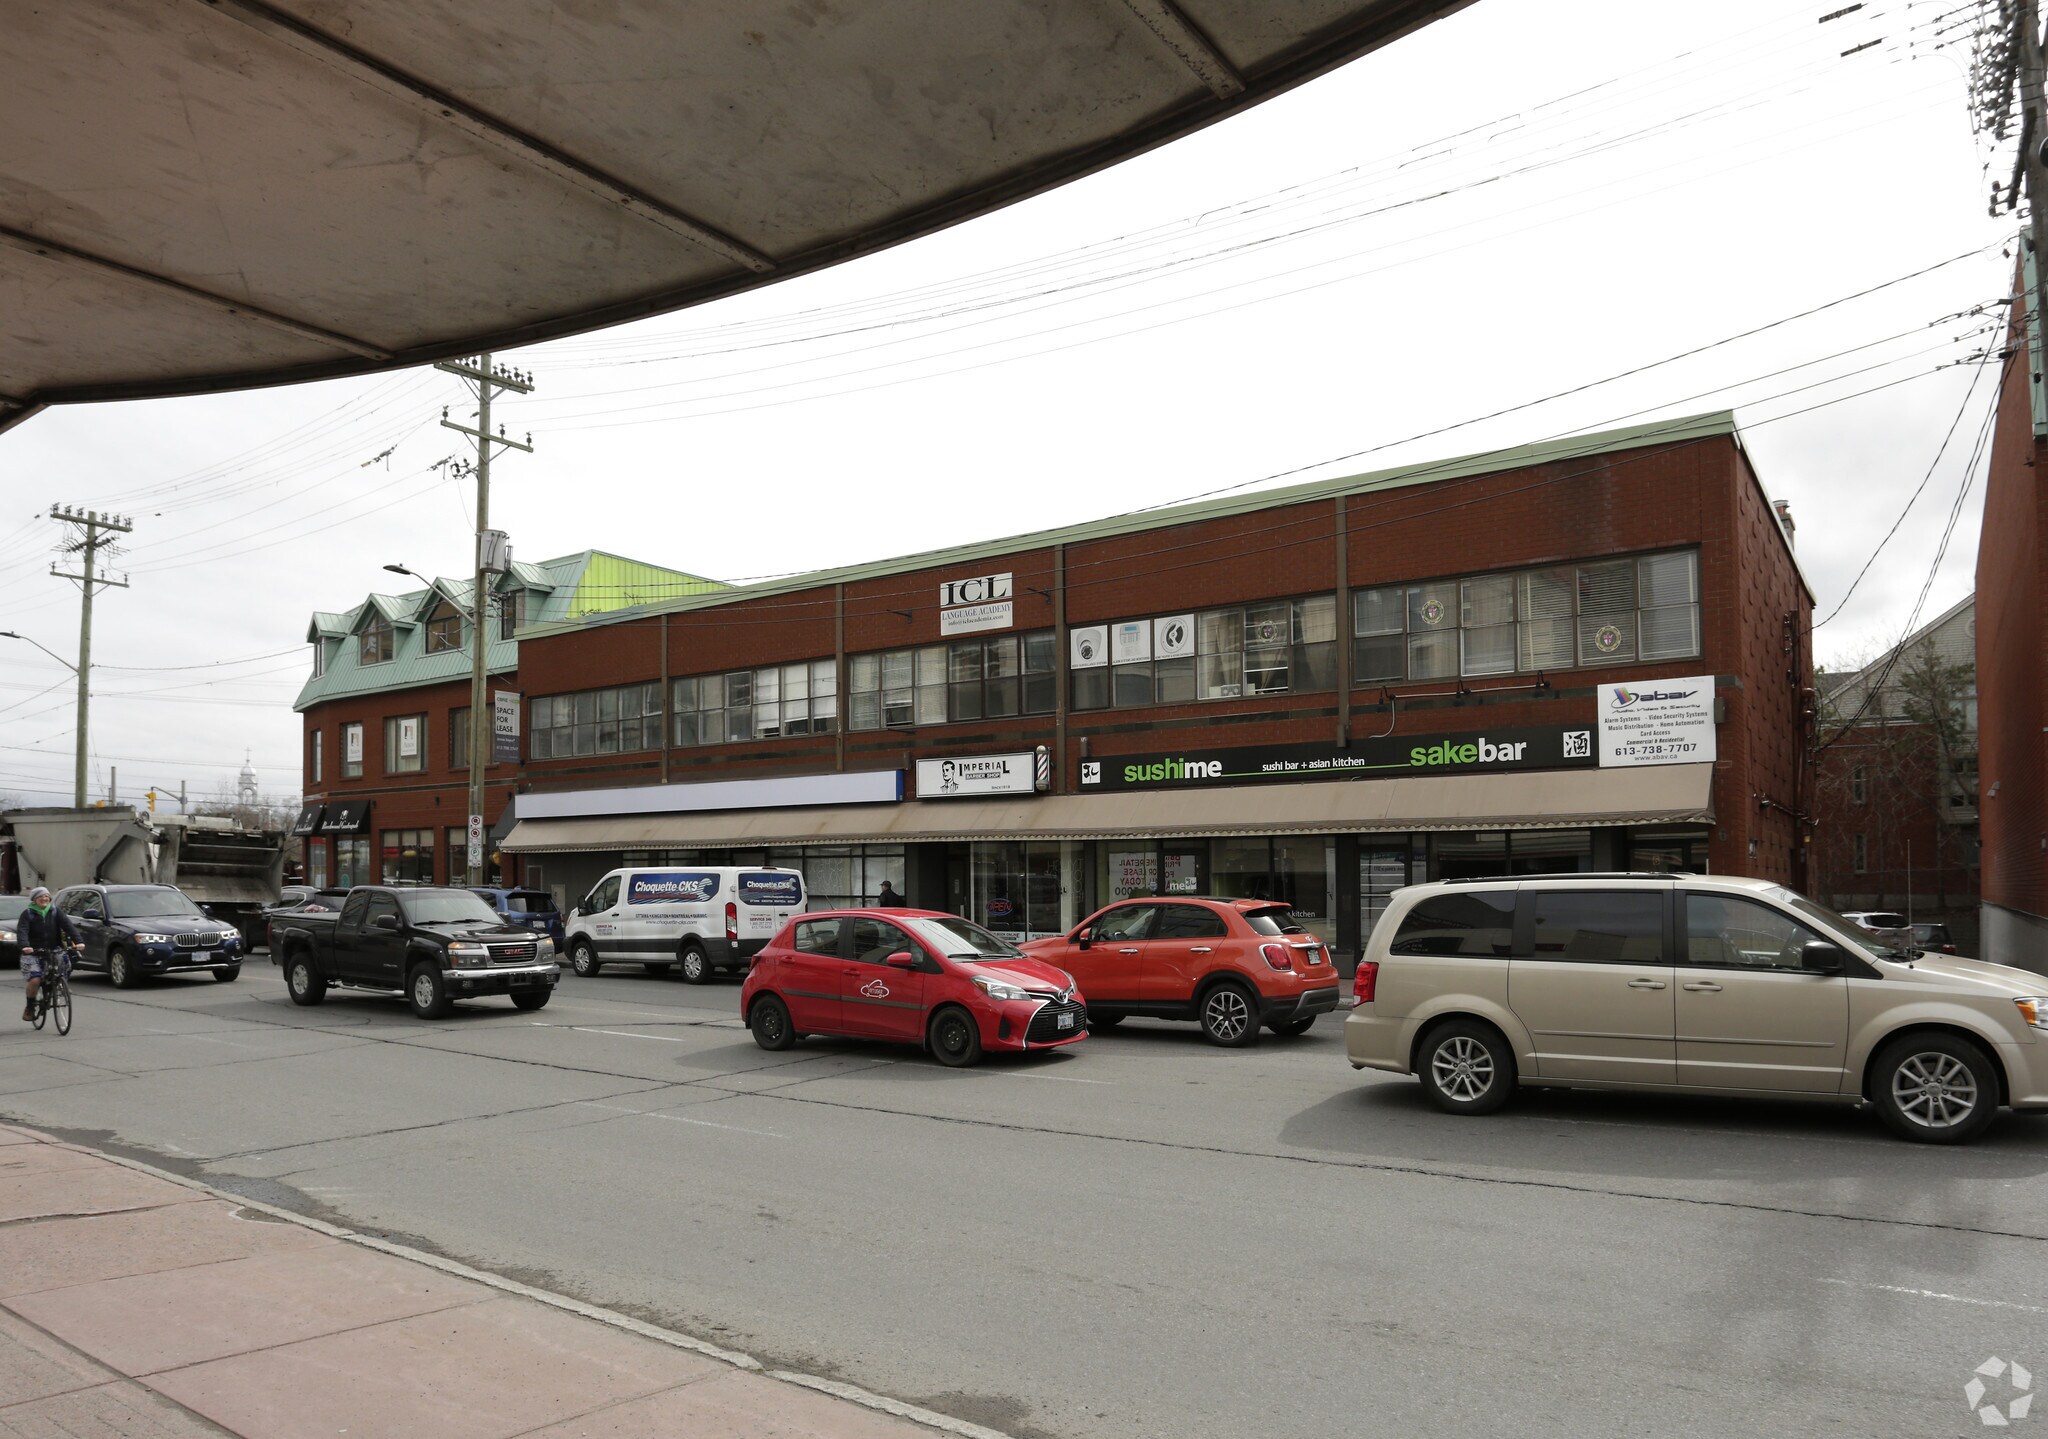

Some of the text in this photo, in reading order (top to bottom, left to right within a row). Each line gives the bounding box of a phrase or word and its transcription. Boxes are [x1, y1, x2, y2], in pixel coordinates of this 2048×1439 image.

[946, 576, 1006, 606] ICL
[942, 603, 1012, 620] LANGUAGE ACADEMY
[1640, 690, 1698, 702] abav
[497, 707, 514, 715] SPACE
[1410, 738, 1527, 766] sakebar
[1616, 744, 1697, 756] 613-738-7707
[959, 761, 1010, 776] IMPERIAL
[1124, 758, 1222, 782] sushime
[1262, 762, 1283, 771] sushi
[1285, 761, 1299, 770] bar
[1309, 760, 1330, 769] asian
[1332, 757, 1365, 767] kitchen
[635, 881, 698, 893] Choquette CKS
